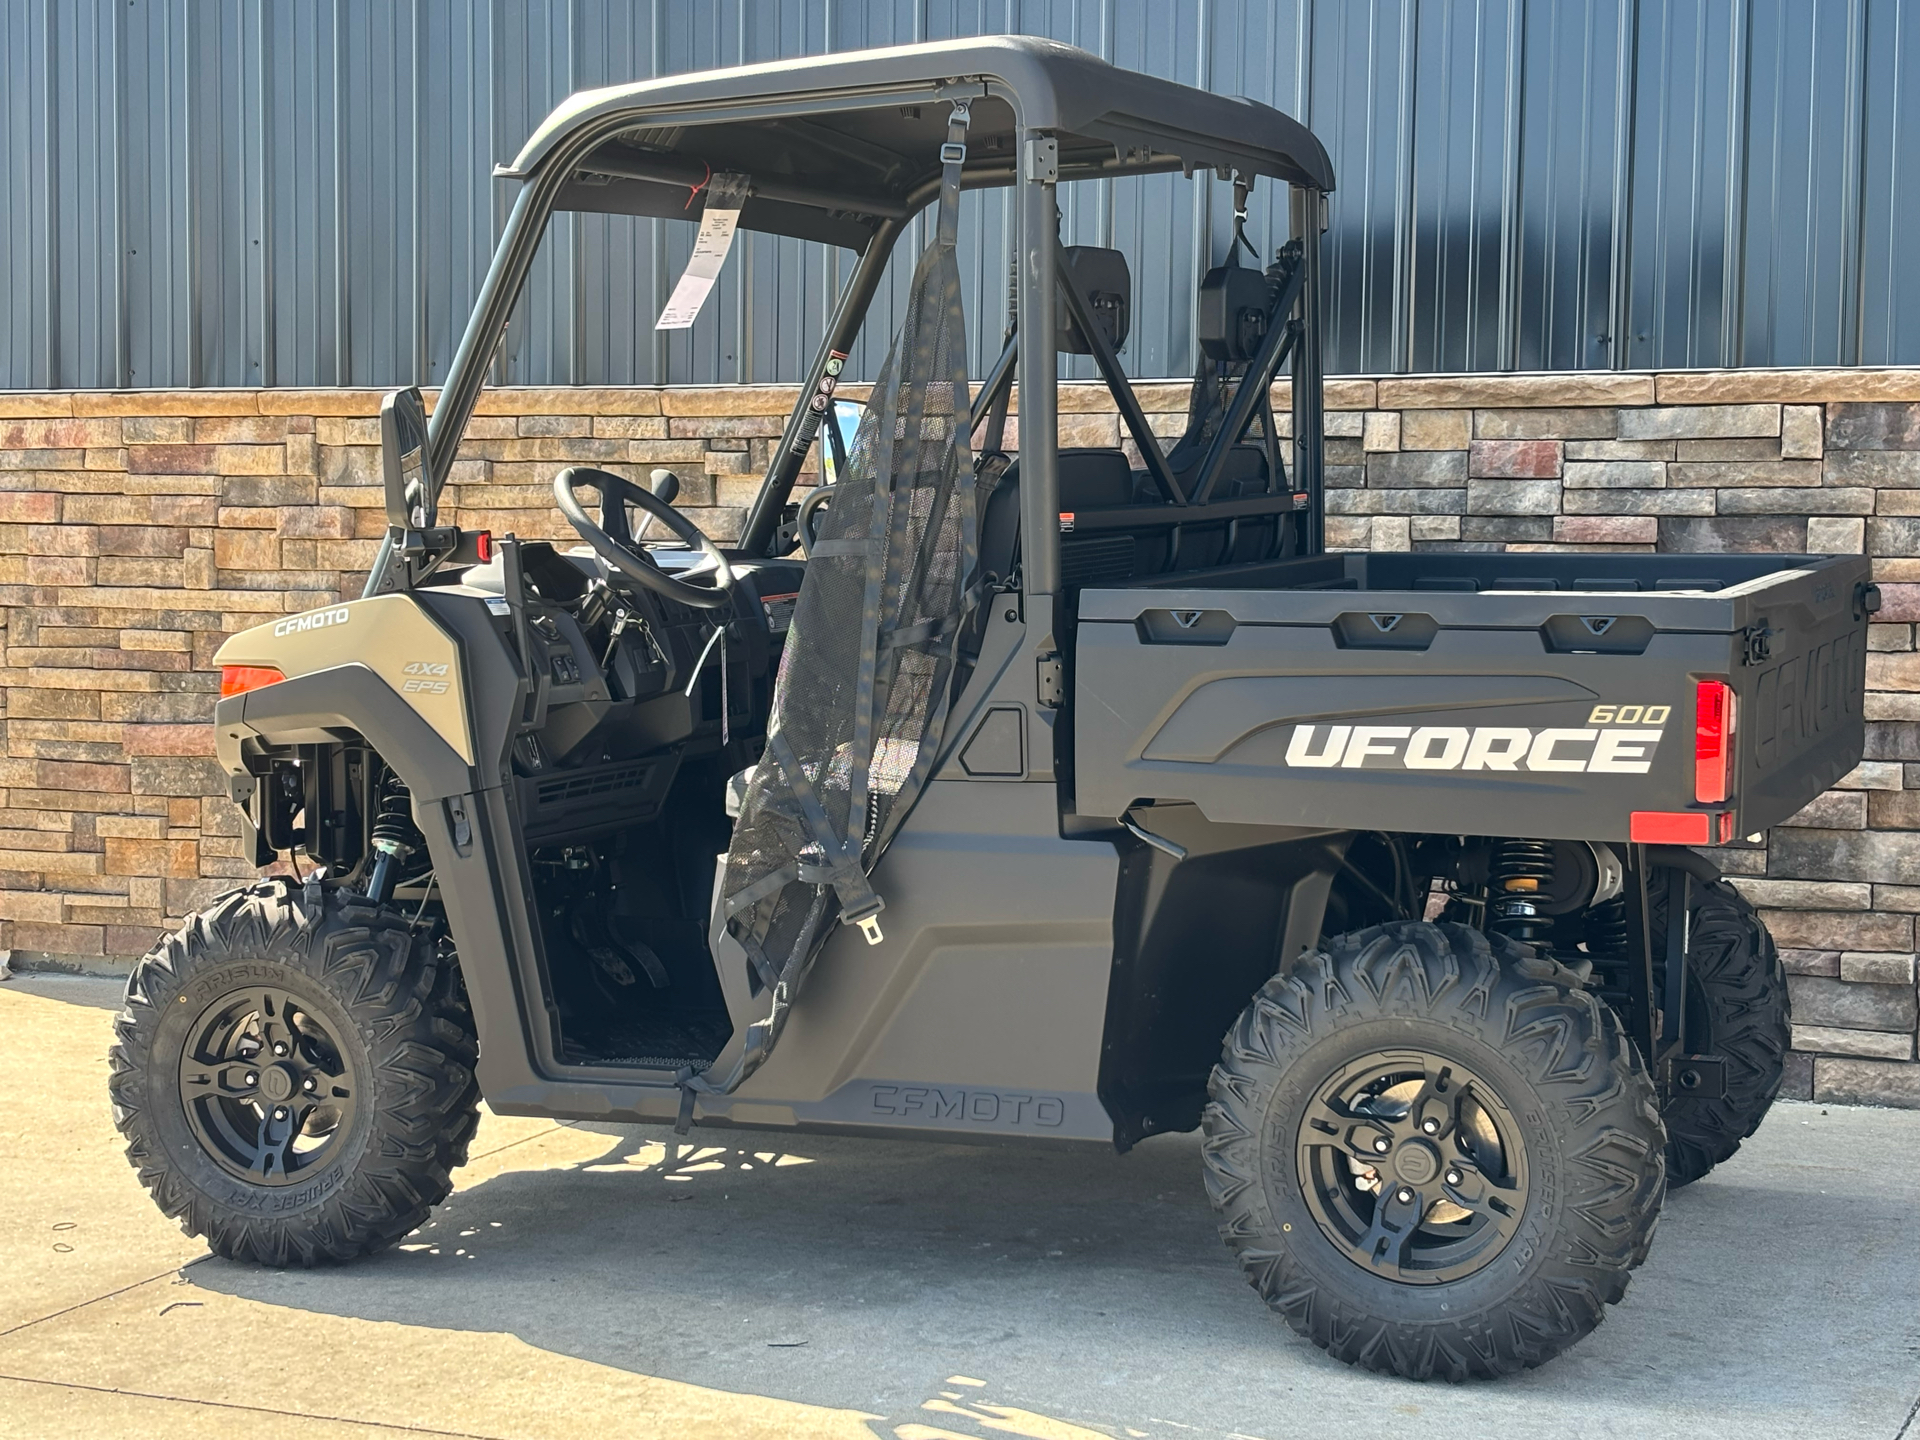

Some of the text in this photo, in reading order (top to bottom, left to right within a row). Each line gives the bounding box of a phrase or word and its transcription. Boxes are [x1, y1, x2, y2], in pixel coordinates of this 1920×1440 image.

[274, 608, 349, 638] CFMOTO
[402, 680, 449, 695] EPS
[1588, 705, 1671, 725] 600
[1285, 725, 1665, 774] UFORCE
[870, 1085, 1065, 1127] CFMOTO
[1268, 1079, 1303, 1202] ARISUN
[1525, 1109, 1555, 1219] BRUISER
